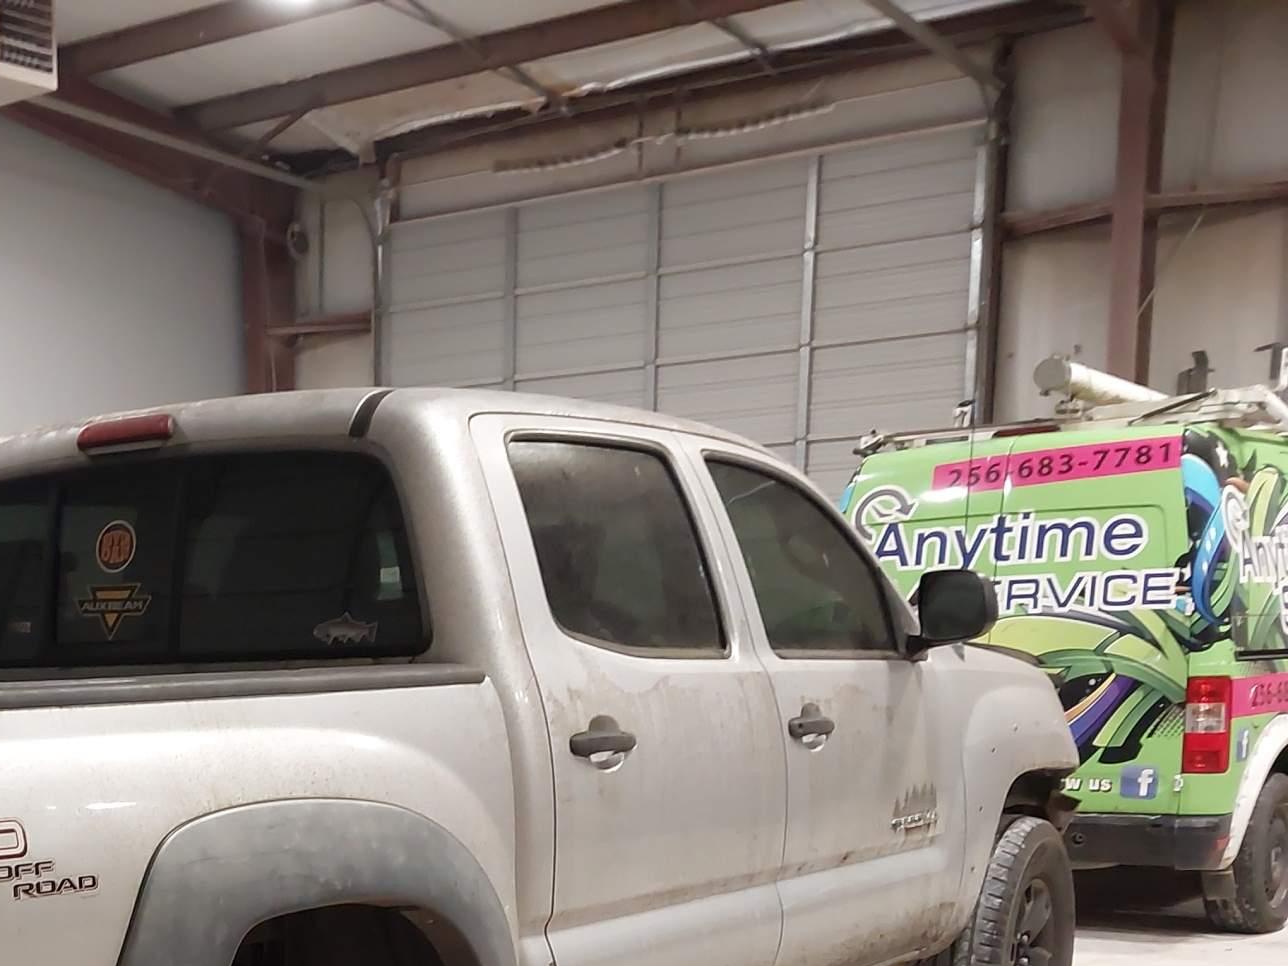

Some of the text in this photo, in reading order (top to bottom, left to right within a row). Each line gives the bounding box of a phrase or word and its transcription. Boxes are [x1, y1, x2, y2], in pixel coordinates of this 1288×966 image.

[948, 442, 1173, 487] 256-683-7781
[874, 511, 1145, 570] Anytime
[993, 573, 1177, 613] RVICE
[1088, 778, 1112, 791] us
[12, 874, 99, 900] ROAD
